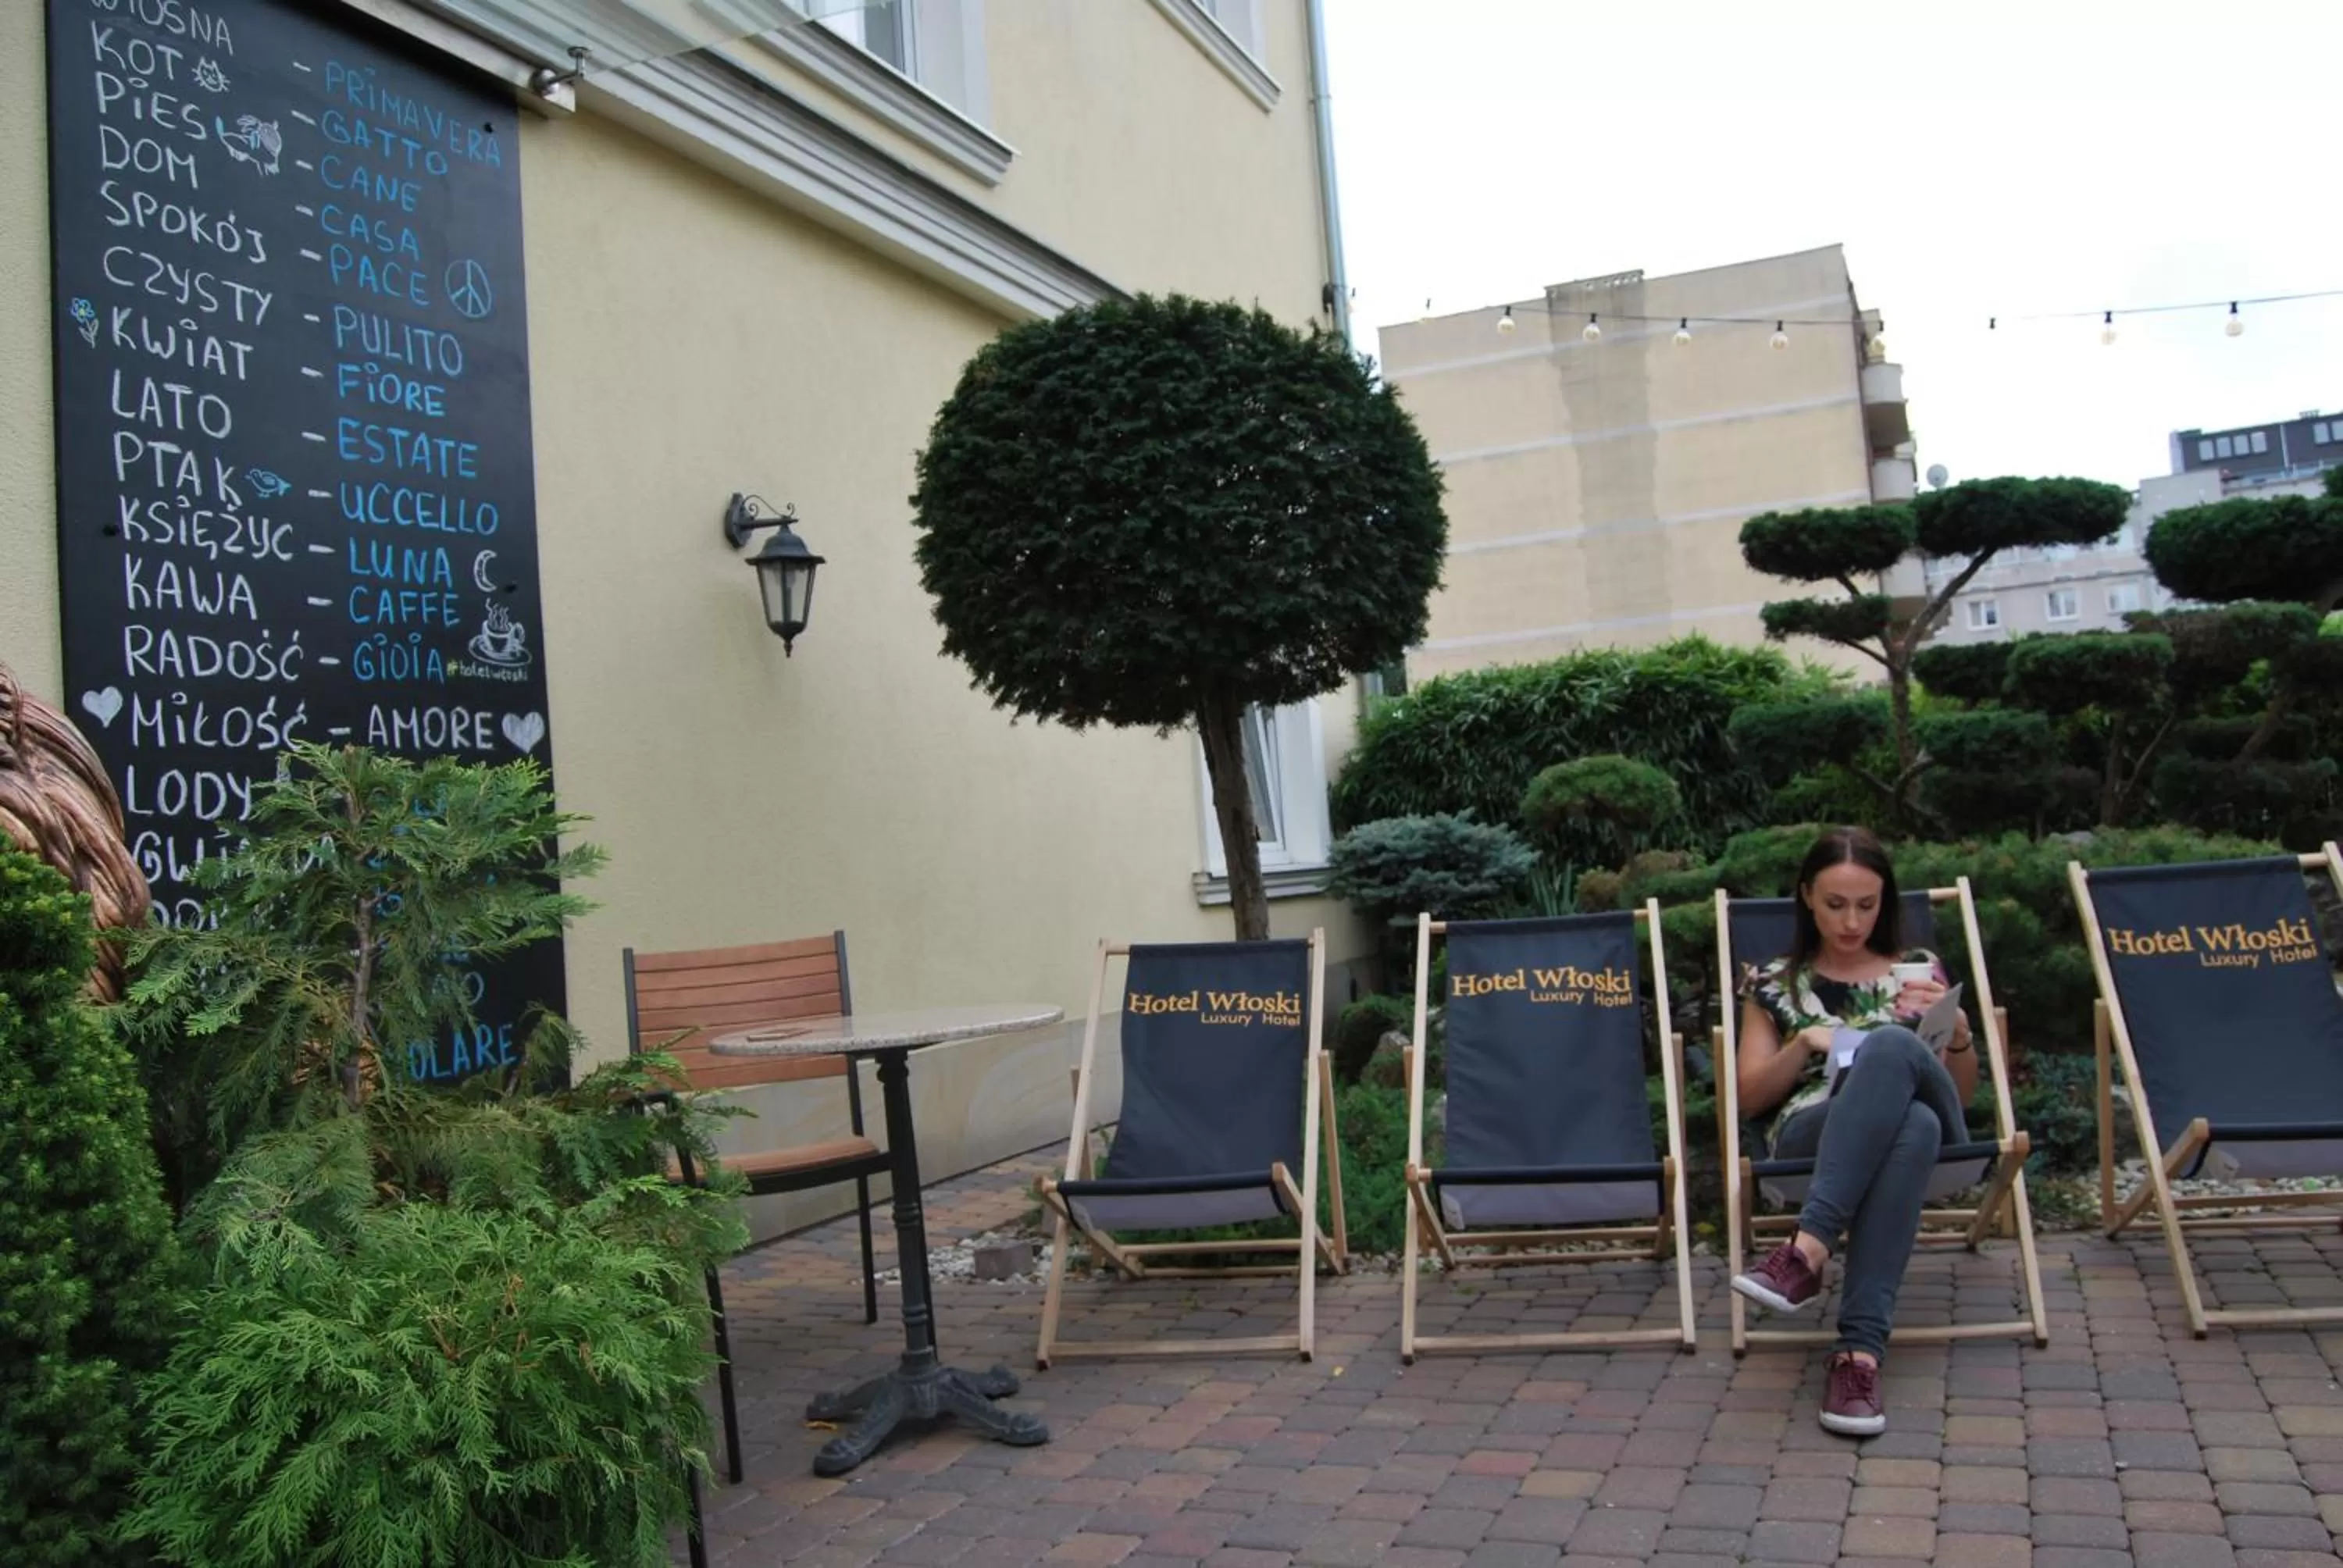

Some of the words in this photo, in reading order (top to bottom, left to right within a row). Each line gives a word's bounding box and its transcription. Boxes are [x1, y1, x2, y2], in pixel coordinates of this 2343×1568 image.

[91, 20, 184, 80] KOT
[321, 109, 448, 175] GATTO
[99, 124, 198, 189] DOM
[321, 204, 419, 262] CASA
[321, 155, 422, 212] CANE
[100, 180, 266, 263] SPOKÓJ
[330, 244, 429, 305] PACE
[103, 246, 272, 325] CZYSTY
[333, 303, 462, 376] PULITO
[112, 369, 231, 439] LATO
[337, 417, 478, 478] ESTATE
[113, 431, 242, 506] PTAK
[341, 481, 498, 535] UCCELLO
[124, 553, 257, 620] KAWA
[349, 586, 461, 626] CAFFE
[349, 537, 452, 587] LUNA
[124, 625, 304, 682] RADOŚĆ
[368, 704, 494, 750] AMORE
[127, 764, 251, 821] LODY
[2107, 925, 2195, 955] Hotel
[2195, 918, 2314, 951] Włoski
[2199, 952, 2259, 968] Luxury
[2269, 943, 2317, 964] Hotel
[1129, 990, 1200, 1014] Hotel
[1206, 990, 1300, 1014] Włoski
[1451, 968, 1526, 996] Hotel
[1532, 966, 1631, 992] Włoski
[1530, 989, 1585, 1005] Luxury
[1593, 991, 1632, 1007] Hotel
[1200, 1011, 1252, 1028] Luxury
[1261, 1013, 1300, 1026] Hotel
[390, 1022, 517, 1082] OLARE
